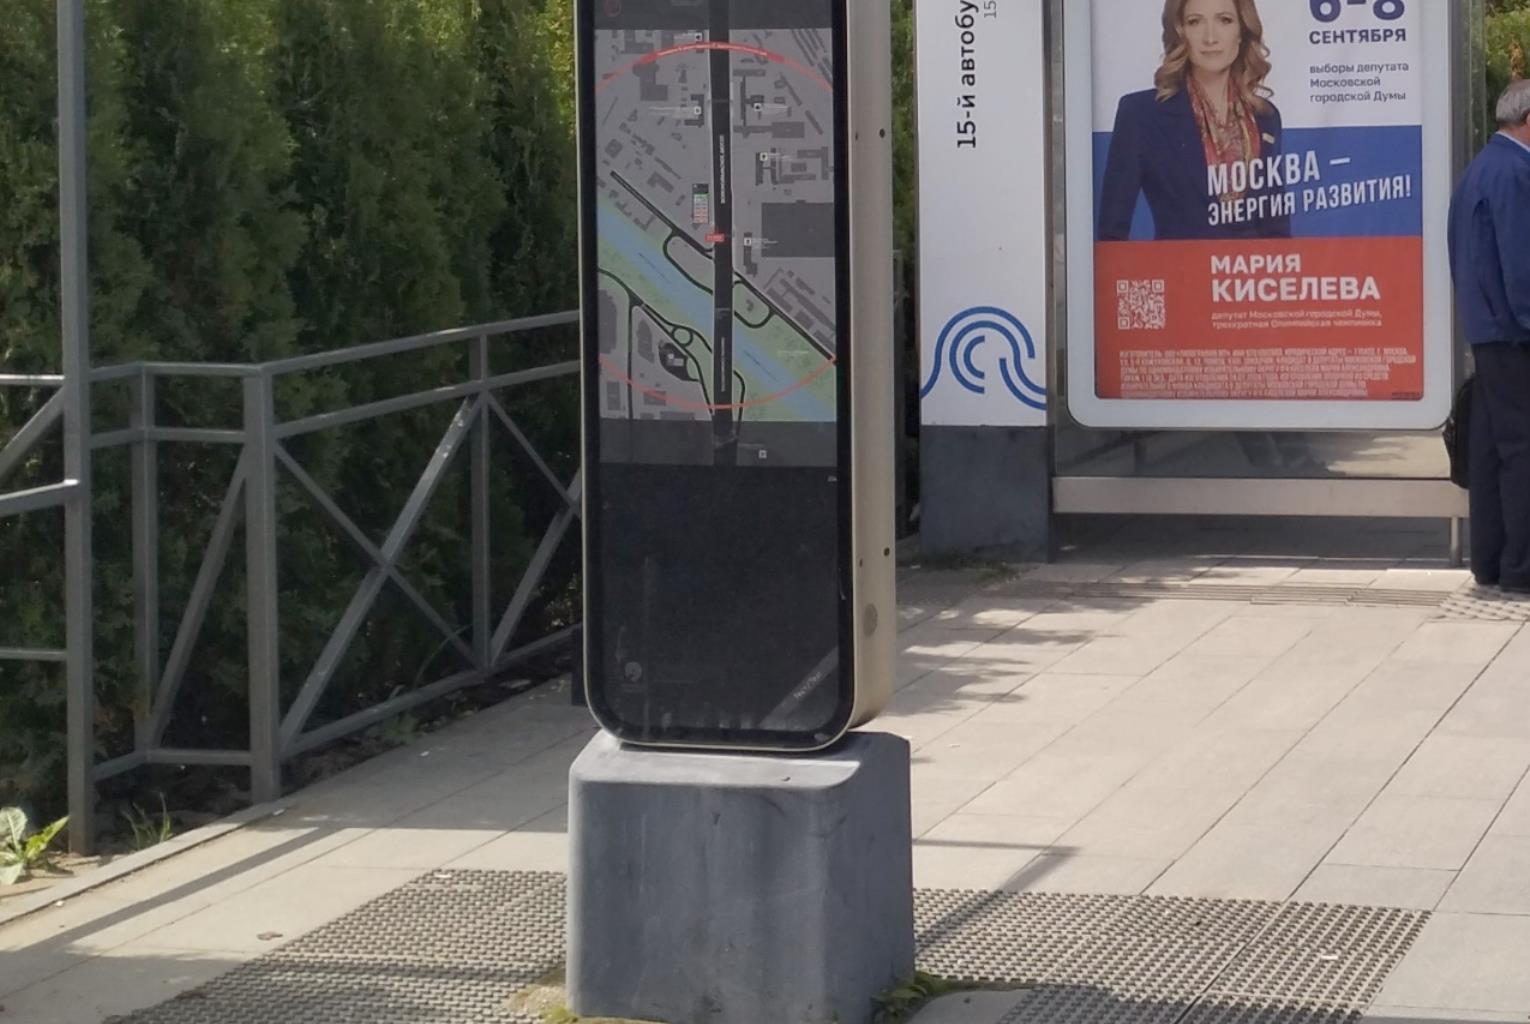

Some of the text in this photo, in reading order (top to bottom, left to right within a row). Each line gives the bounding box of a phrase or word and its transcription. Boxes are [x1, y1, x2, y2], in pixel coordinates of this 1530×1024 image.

[984, 0, 997, 19] 15
[1308, 28, 1407, 45] СЕНТЯБРЯ
[1309, 63, 1409, 74] выборы депутата
[1309, 77, 1381, 88] Московской
[1310, 91, 1406, 104] городской Думы
[956, 93, 977, 148] 15-й
[1207, 150, 1320, 196] МОСКВА
[1208, 174, 1411, 226] ЭНЕРГИЯ РАЗВИТИЯ!
[1211, 253, 1300, 274] МАРИЯ
[1212, 276, 1381, 302] КИСЕЛЕВА
